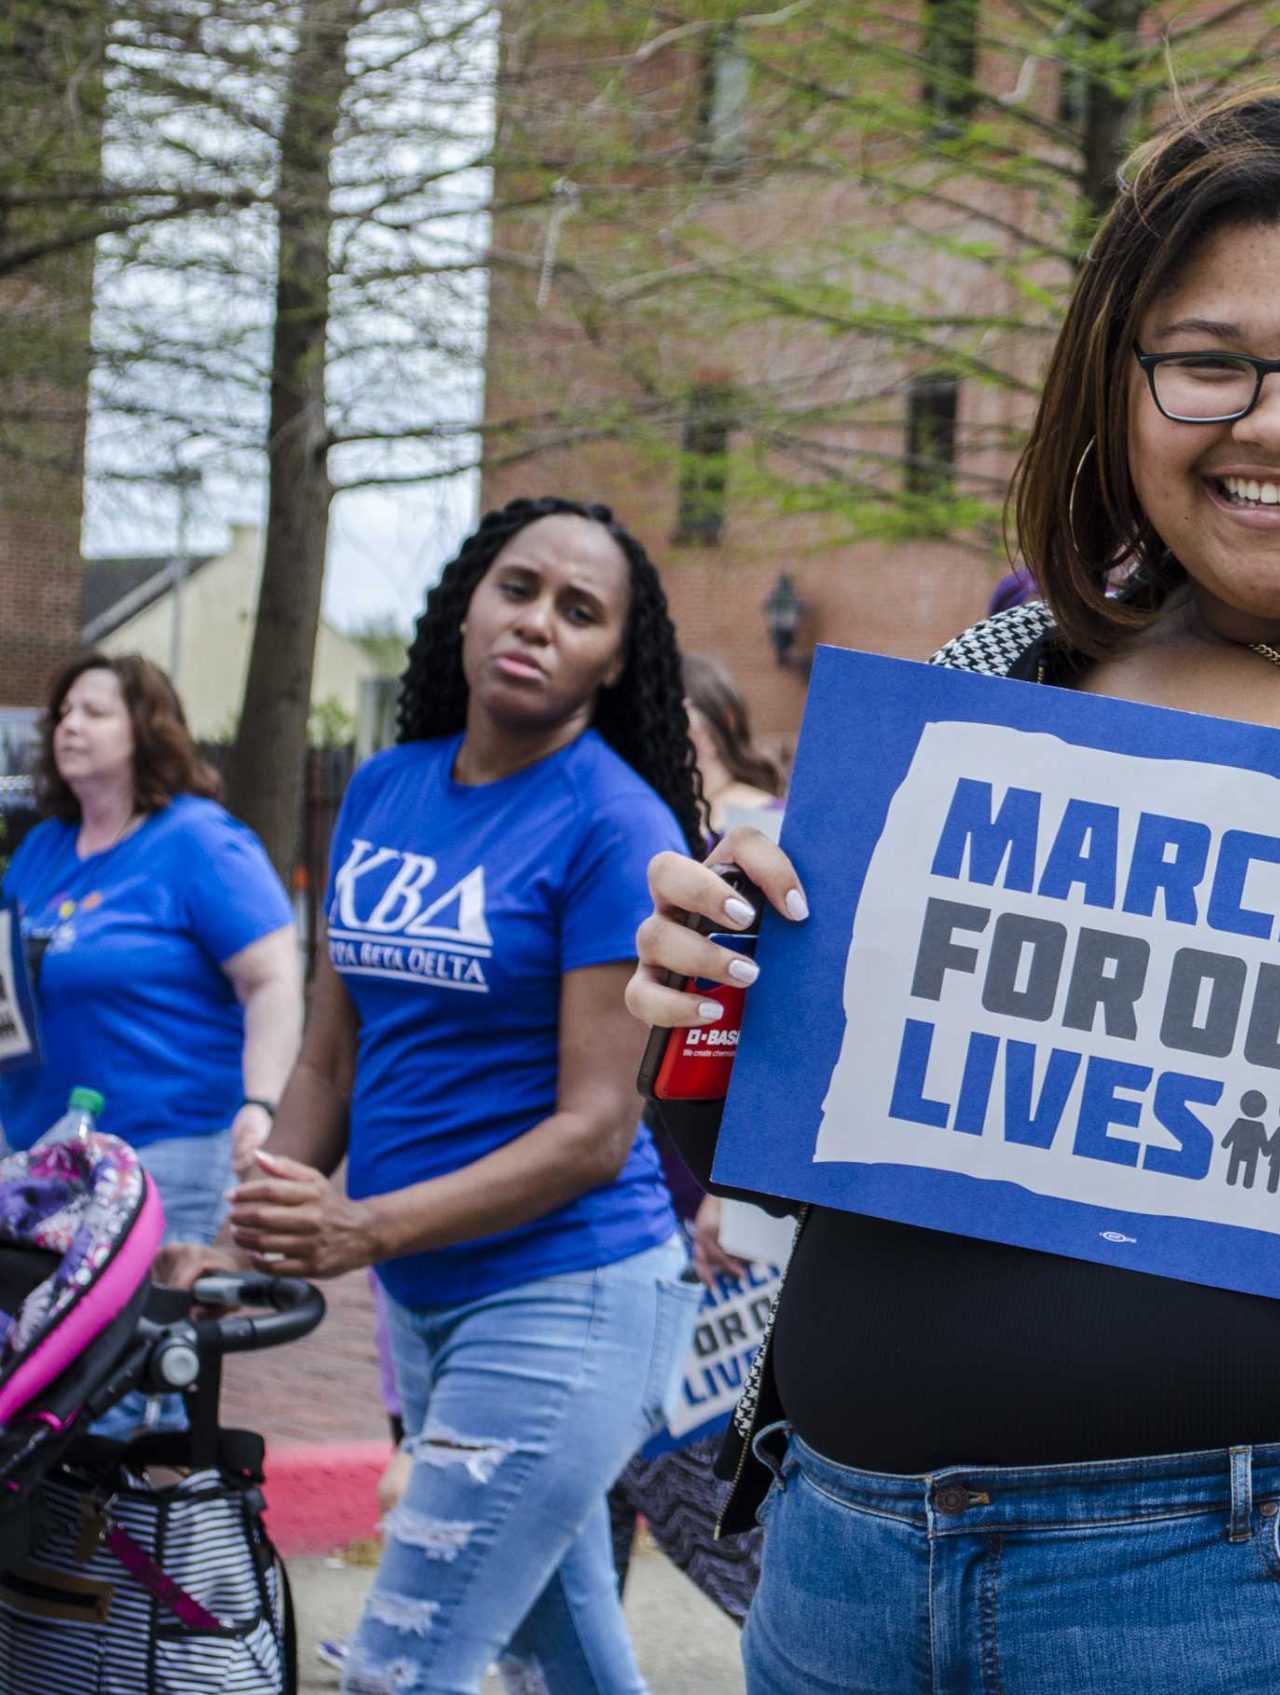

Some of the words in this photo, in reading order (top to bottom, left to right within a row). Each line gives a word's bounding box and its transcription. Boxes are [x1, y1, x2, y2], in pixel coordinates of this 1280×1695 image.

[408, 947, 486, 984] DELTA
[910, 897, 1150, 1041] FOR
[706, 1029, 740, 1046] BAS
[888, 1018, 1225, 1181] LIVES
